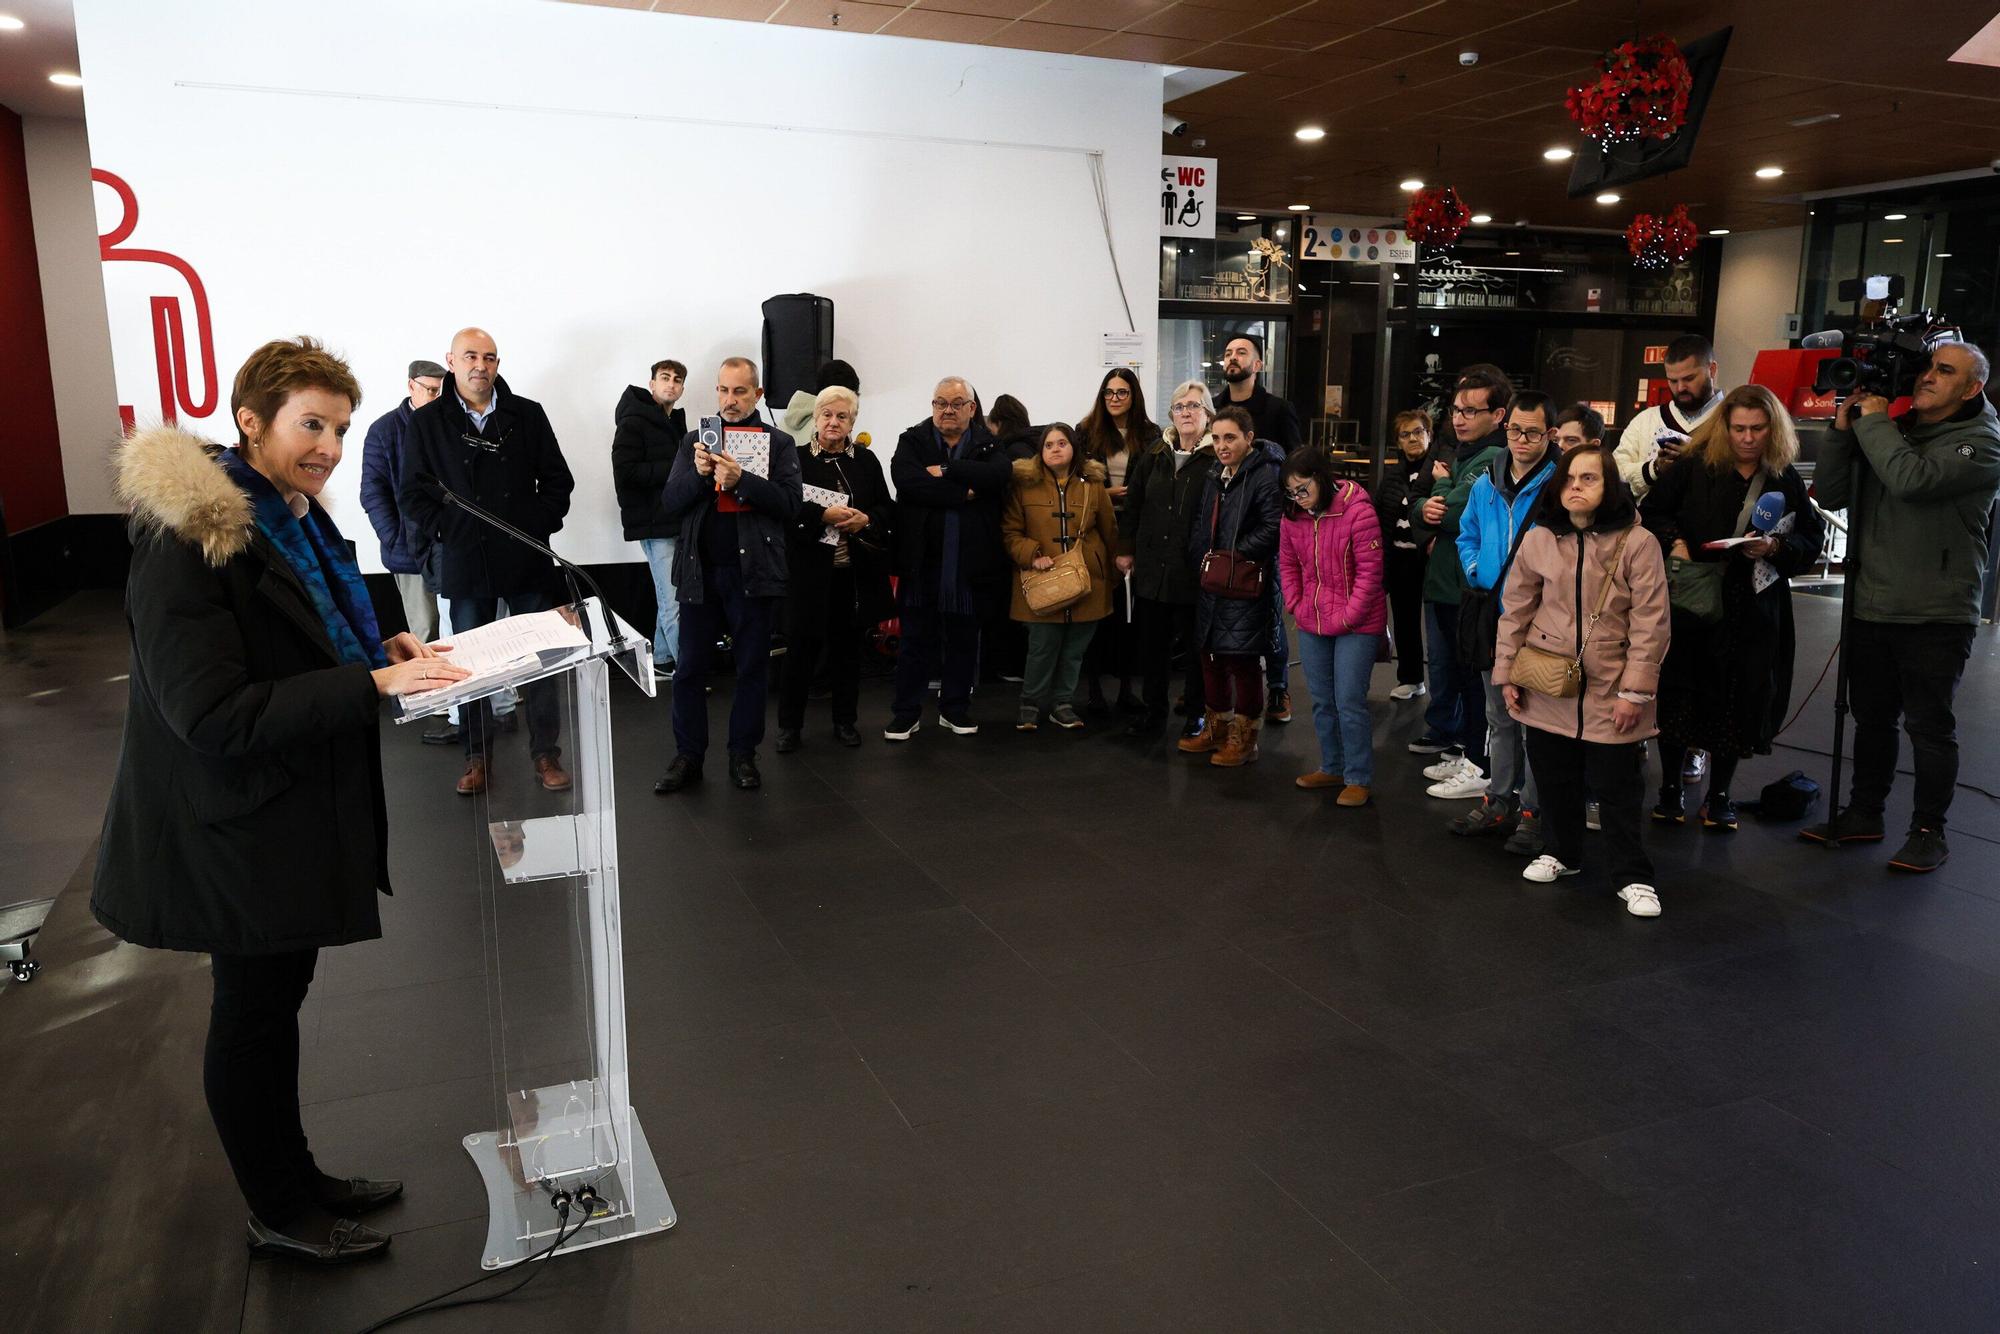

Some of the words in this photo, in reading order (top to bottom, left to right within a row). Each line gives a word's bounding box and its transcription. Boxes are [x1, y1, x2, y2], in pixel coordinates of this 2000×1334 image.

[1177, 166, 1205, 187] WC
[1304, 228, 1318, 257] 2
[1756, 505, 1772, 521] tve
